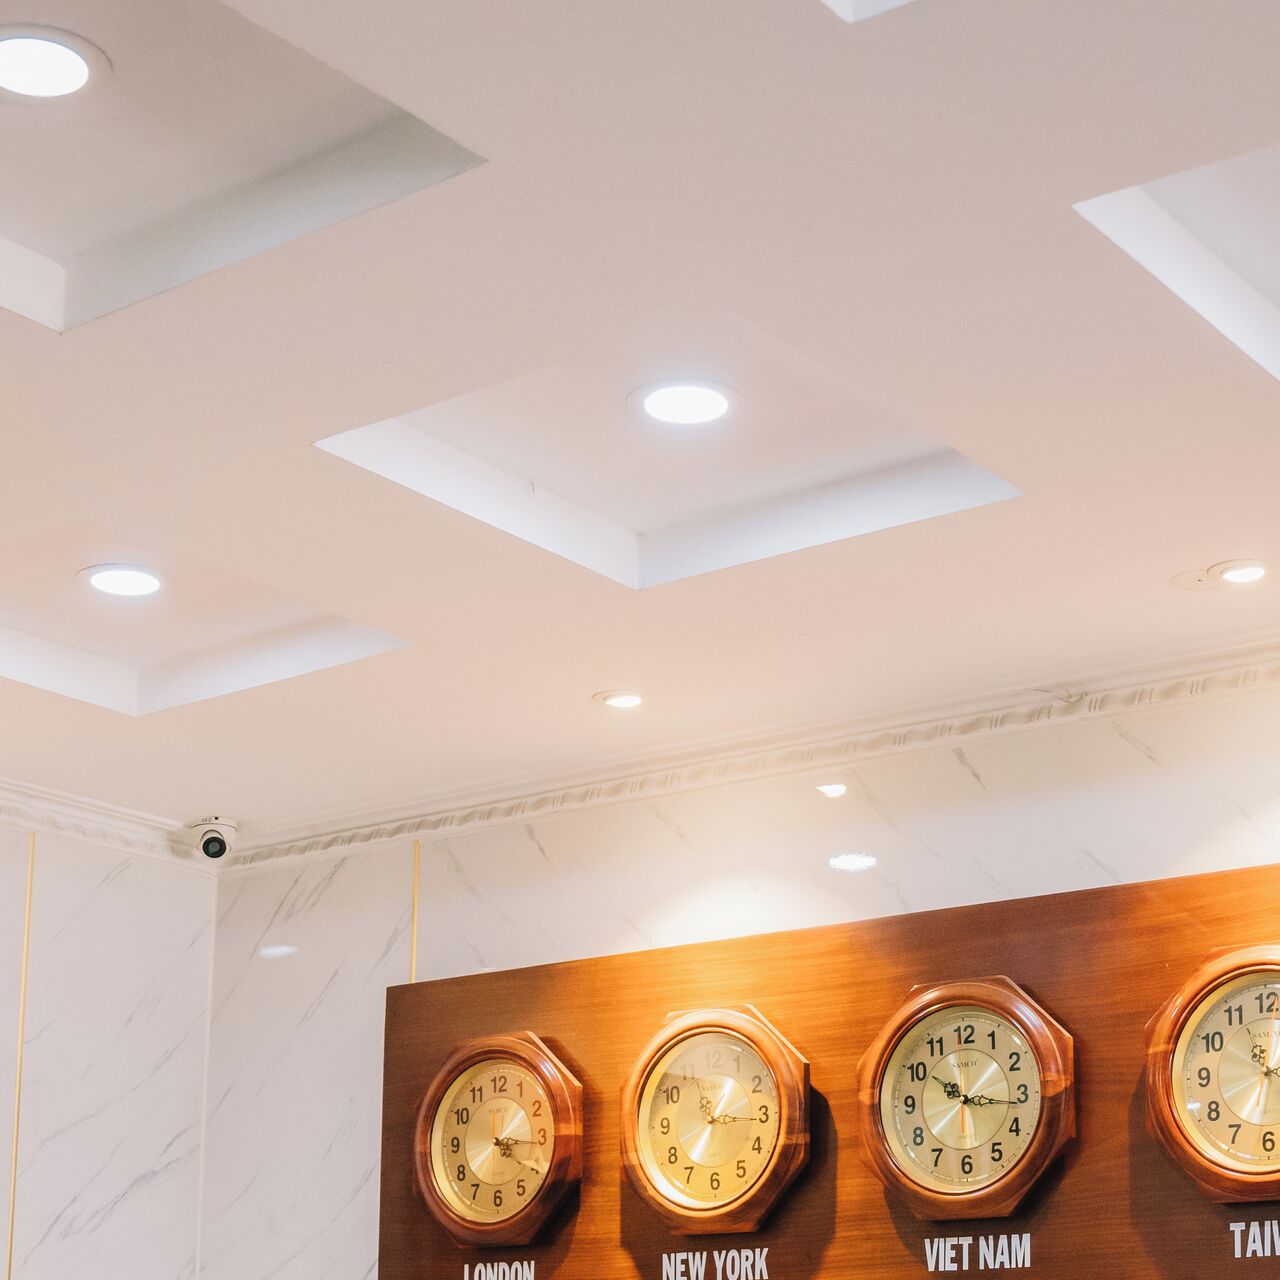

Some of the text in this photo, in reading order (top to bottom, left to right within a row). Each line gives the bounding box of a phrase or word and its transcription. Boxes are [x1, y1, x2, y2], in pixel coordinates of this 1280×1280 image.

[1255, 992, 1279, 1013] 12
[1224, 1005, 1243, 1026] 11
[954, 1025, 975, 1045] 12
[988, 1030, 995, 1050] 1
[1202, 1032, 1223, 1053] 10
[927, 1037, 944, 1056] 11
[705, 1051, 722, 1069] 12
[734, 1055, 740, 1073] 1
[1009, 1052, 1020, 1071] 2
[681, 1062, 695, 1081] 11
[907, 1062, 926, 1082] 10
[1198, 1067, 1210, 1088] 9
[491, 1076, 507, 1093] 12
[517, 1081, 523, 1097] 1
[752, 1076, 762, 1093] 2
[1017, 1084, 1028, 1103] 3
[470, 1086, 483, 1103] 11
[662, 1086, 679, 1104] 10
[533, 1101, 541, 1117] 2
[904, 1095, 915, 1114] 9
[1207, 1101, 1220, 1121] 8
[454, 1108, 469, 1125] 10
[759, 1105, 769, 1123] 3
[661, 1118, 670, 1134] 9
[1009, 1117, 1020, 1136] 4
[1228, 1124, 1241, 1144] 7
[451, 1137, 459, 1153] 9
[538, 1129, 547, 1145] 3
[752, 1136, 762, 1154] 4
[913, 1126, 924, 1146] 8
[1262, 1131, 1275, 1152] 6
[668, 1147, 677, 1164] 8
[932, 1148, 943, 1167] 7
[991, 1142, 1002, 1161] 5
[457, 1165, 465, 1181] 8
[737, 1160, 746, 1178] 5
[961, 1155, 973, 1174] 6
[684, 1166, 694, 1184] 7
[710, 1172, 720, 1190] 6
[472, 1184, 480, 1200] 7
[517, 1180, 525, 1196] 5
[494, 1190, 502, 1207] 6
[924, 1233, 1031, 1271] VIET NAM
